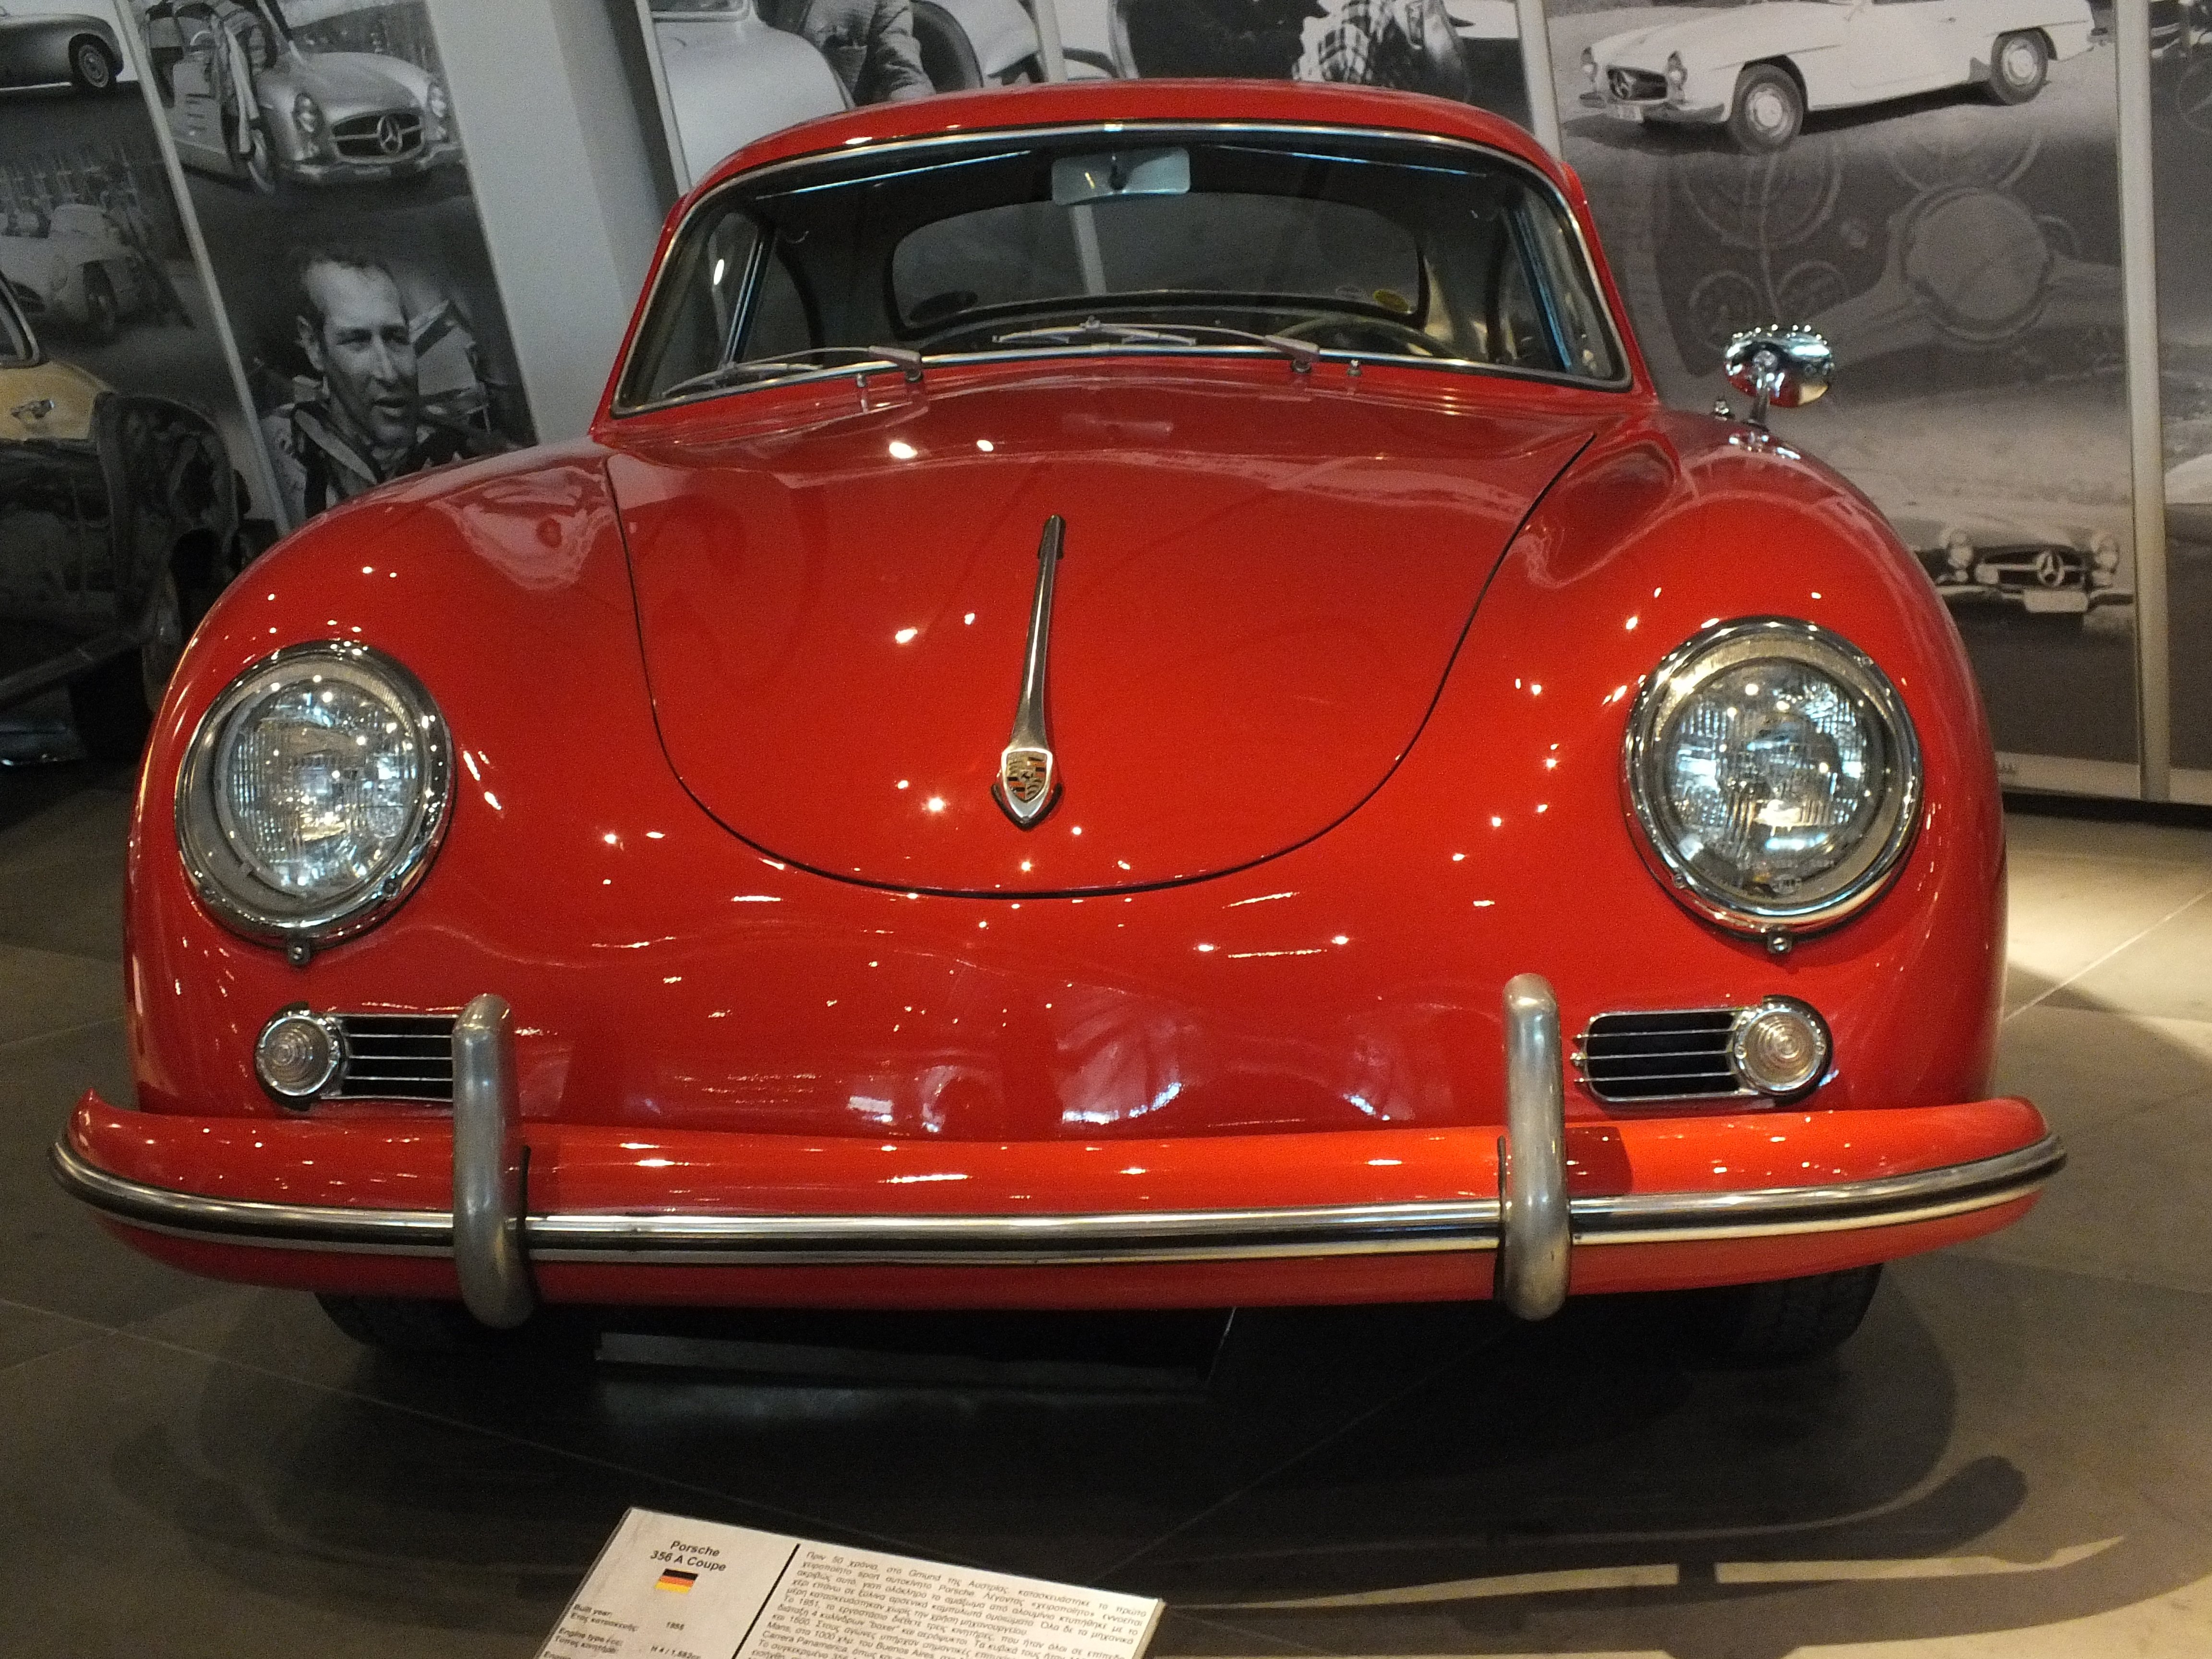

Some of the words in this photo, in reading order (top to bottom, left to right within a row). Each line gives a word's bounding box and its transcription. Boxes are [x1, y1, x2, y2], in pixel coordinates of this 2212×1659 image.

[671, 1540, 720, 1557] Porsche
[650, 1550, 673, 1562] 356
[674, 1555, 683, 1564] A
[687, 1557, 727, 1571] Coupe
